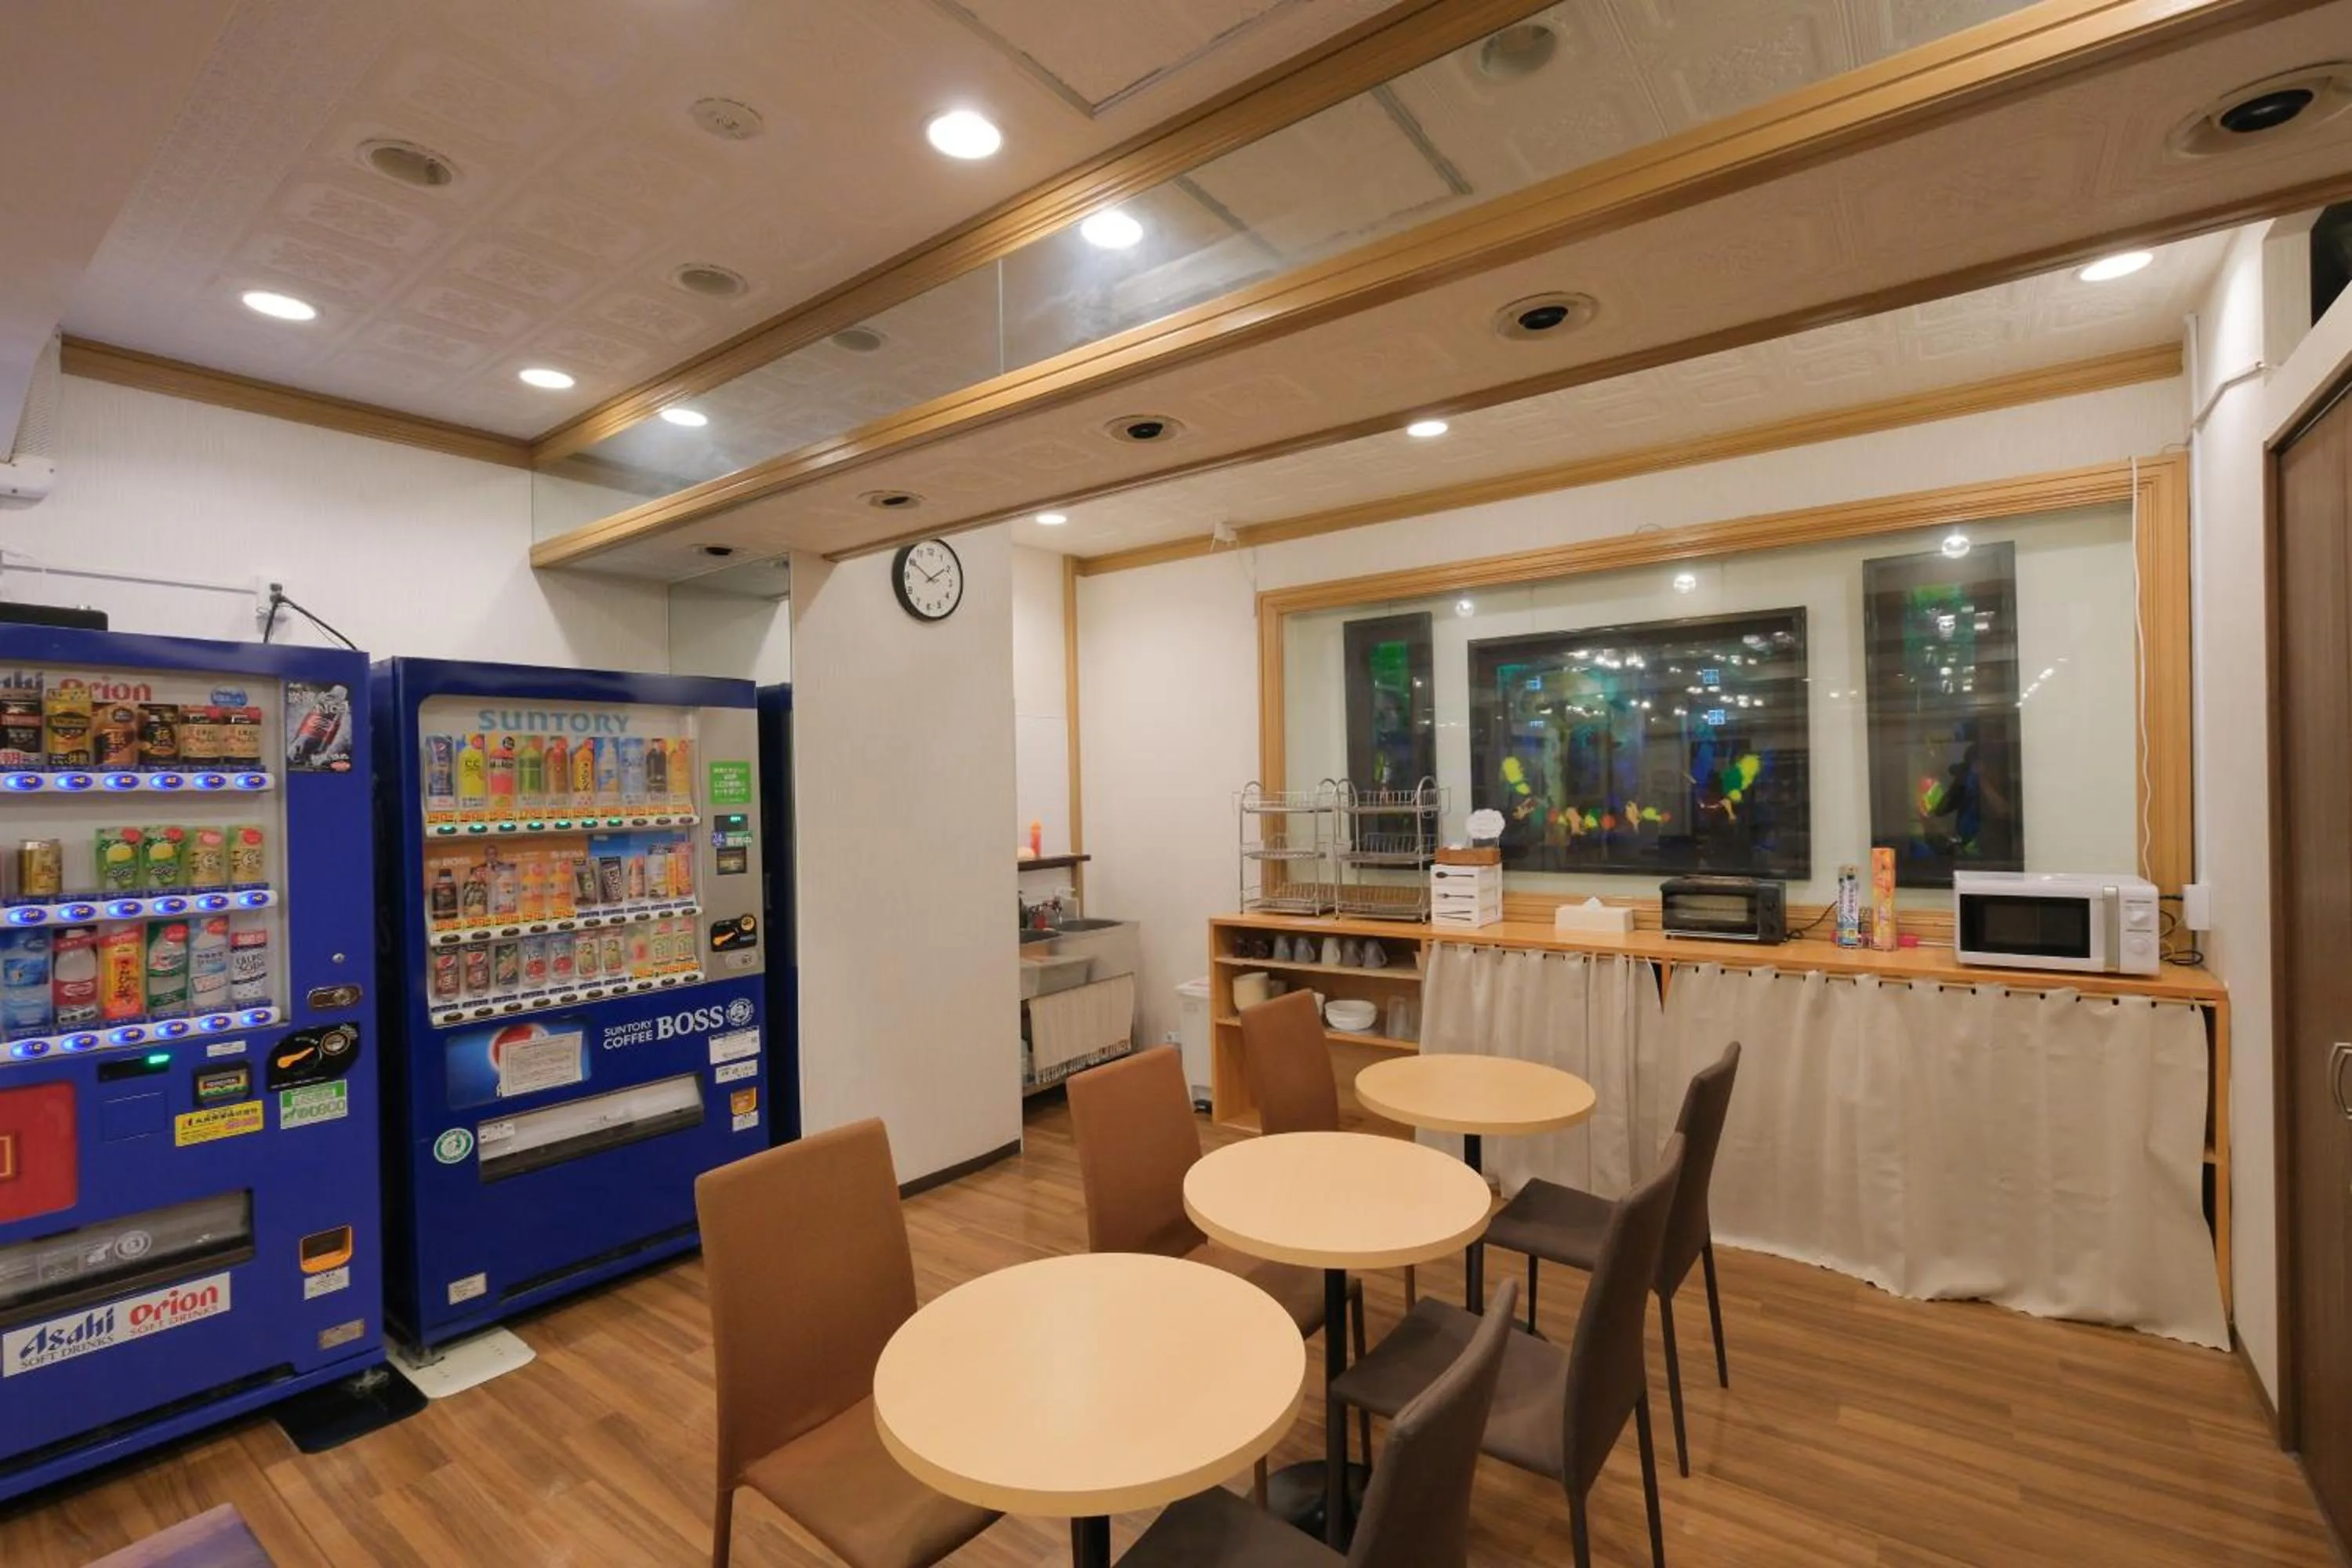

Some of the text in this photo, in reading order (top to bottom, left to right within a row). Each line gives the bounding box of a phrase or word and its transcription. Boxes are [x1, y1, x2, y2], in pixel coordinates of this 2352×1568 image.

[478, 710, 630, 735] SUNTORY
[603, 1029, 653, 1050] COFFEE
[604, 1019, 653, 1037] SUNTORY
[656, 1005, 724, 1041] BOSS
[129, 1285, 219, 1326] Orion
[129, 1305, 219, 1336] SOFT DRINKS
[20, 1307, 114, 1359] Asahi
[20, 1335, 114, 1370] SOFT DRINKS
